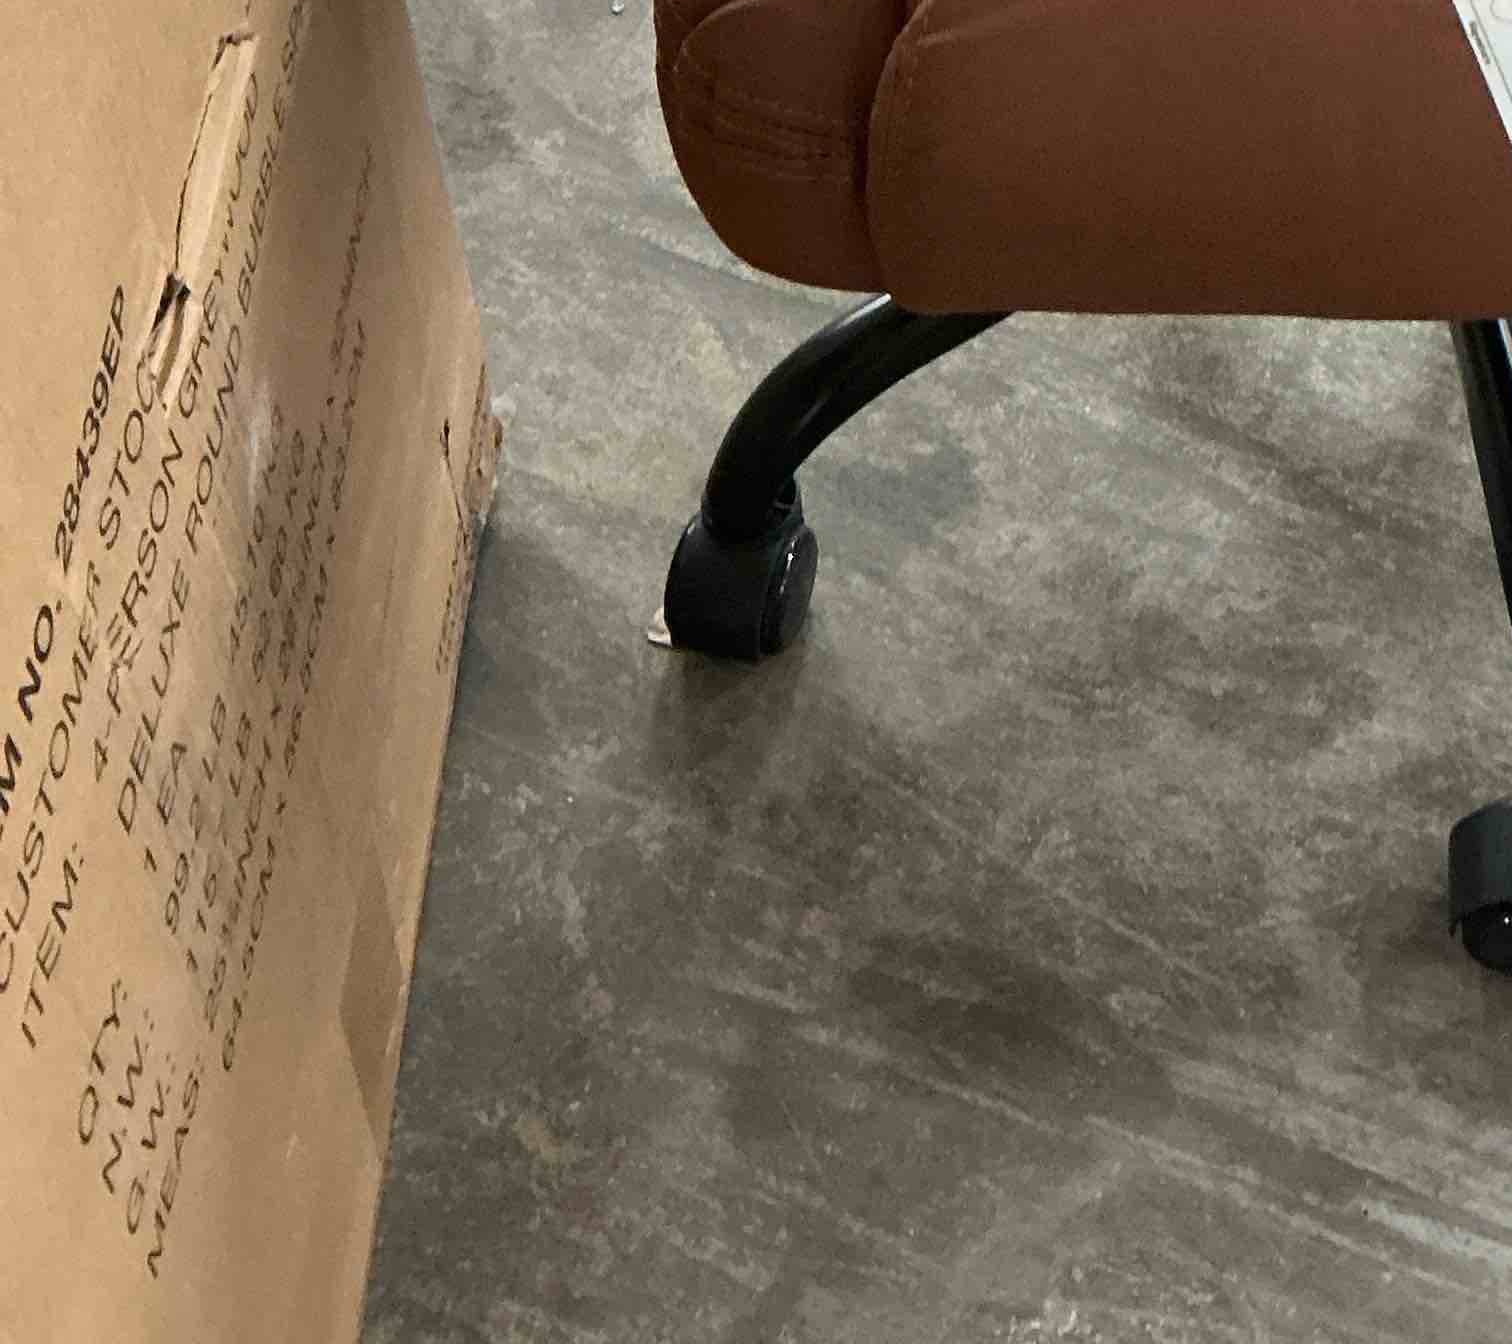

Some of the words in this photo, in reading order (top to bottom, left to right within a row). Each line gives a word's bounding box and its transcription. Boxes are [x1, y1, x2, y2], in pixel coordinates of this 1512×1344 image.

[18, 600, 63, 724] NO.
[55, 285, 125, 576] 28439EP
[117, 558, 191, 834] DELUXE
[182, 324, 242, 553] ROUND
[238, 82, 285, 314] BUBBLE
[0, 561, 101, 995] CUSTOMER
[99, 350, 170, 551] STOC
[21, 841, 85, 1049] ITEM:
[94, 428, 183, 782] 4-PERSON
[164, 793, 204, 935] 99.2
[202, 693, 227, 783] LB
[229, 712, 252, 799] LB
[78, 977, 128, 1145] QTY:
[143, 846, 158, 874] 1
[157, 739, 188, 827] EA
[145, 1054, 203, 1280] MEAS:
